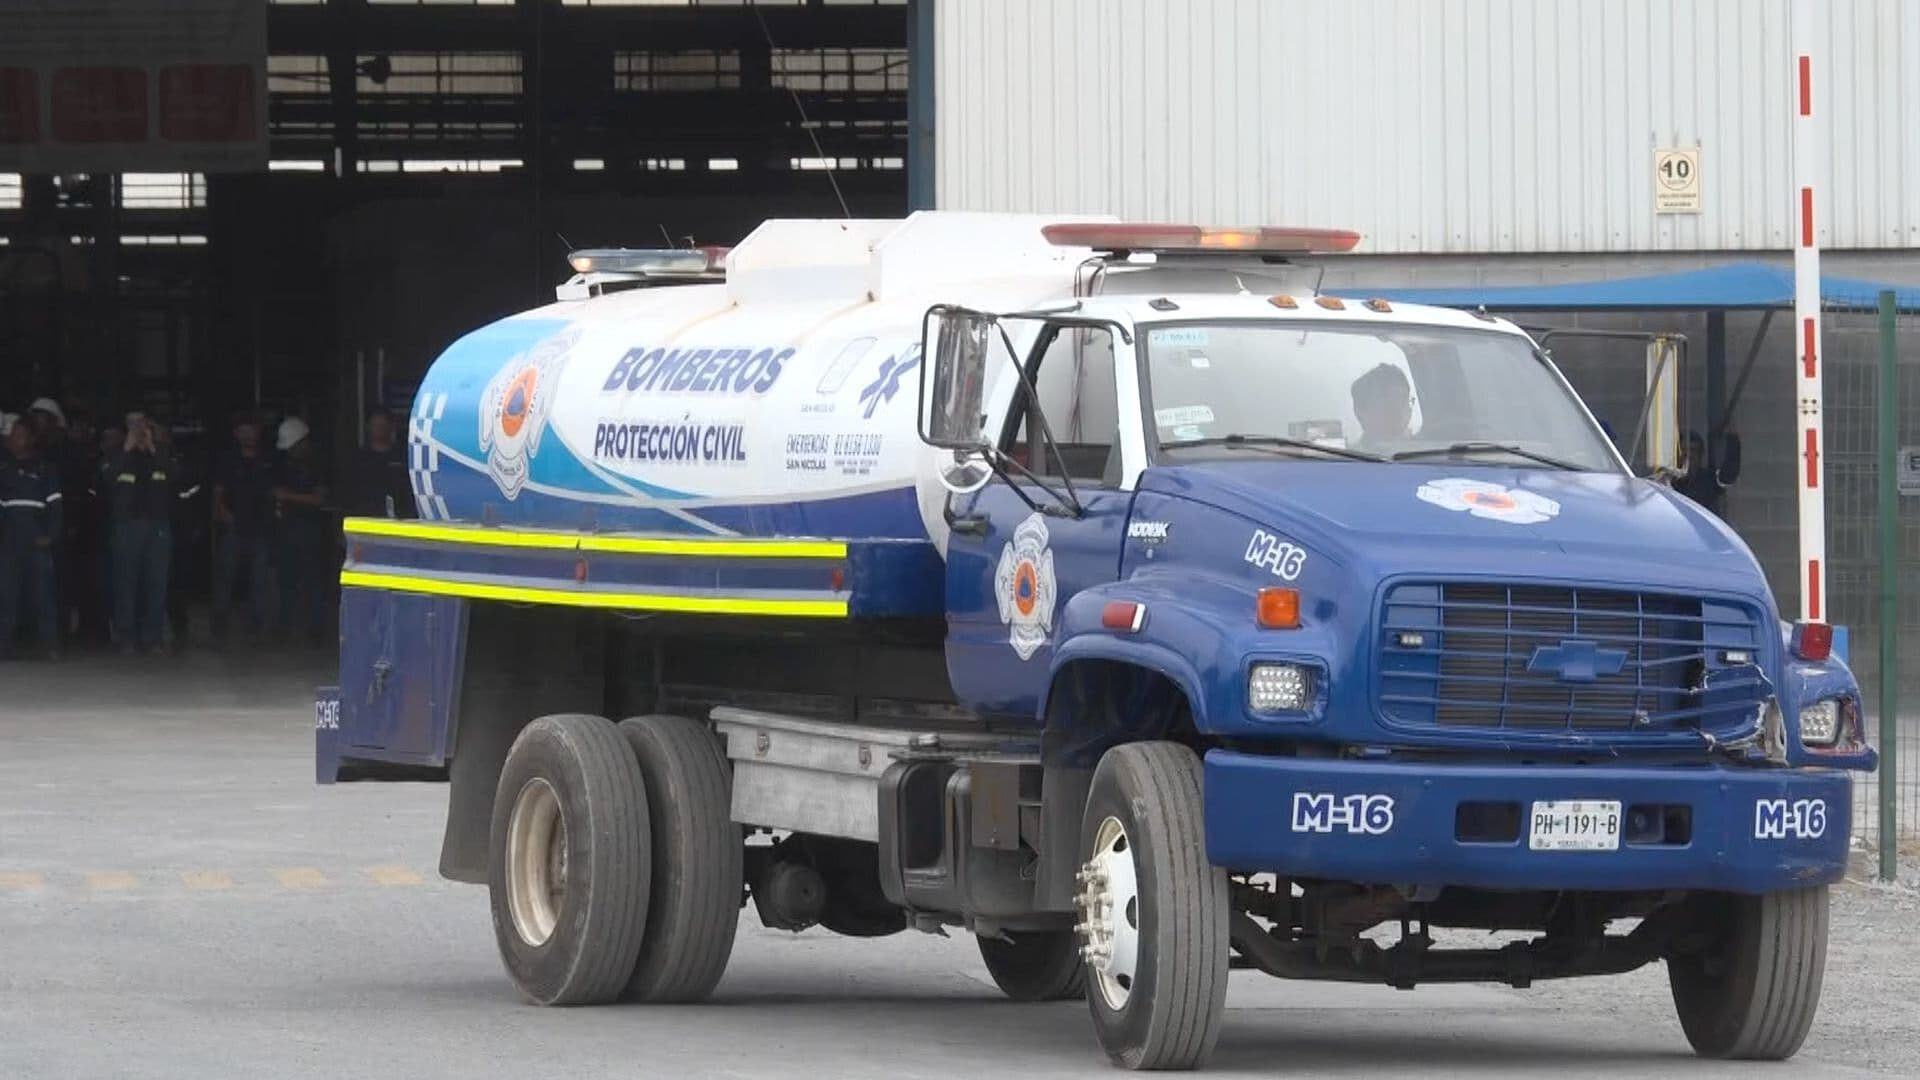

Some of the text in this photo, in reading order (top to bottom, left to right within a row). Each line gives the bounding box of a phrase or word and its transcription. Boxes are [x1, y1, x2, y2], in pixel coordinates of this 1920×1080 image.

[1663, 159, 1690, 179] 10
[602, 346, 796, 393] BOMBEROS
[594, 412, 747, 461] PROTECCIÓN CIVIL
[786, 458, 800, 470] SAN
[1128, 521, 1169, 538] KODIAK
[1244, 529, 1307, 581] M-16
[1292, 792, 1395, 835] M-16
[1534, 814, 1618, 835] PH-1191-B
[1755, 799, 1827, 839] M-16
